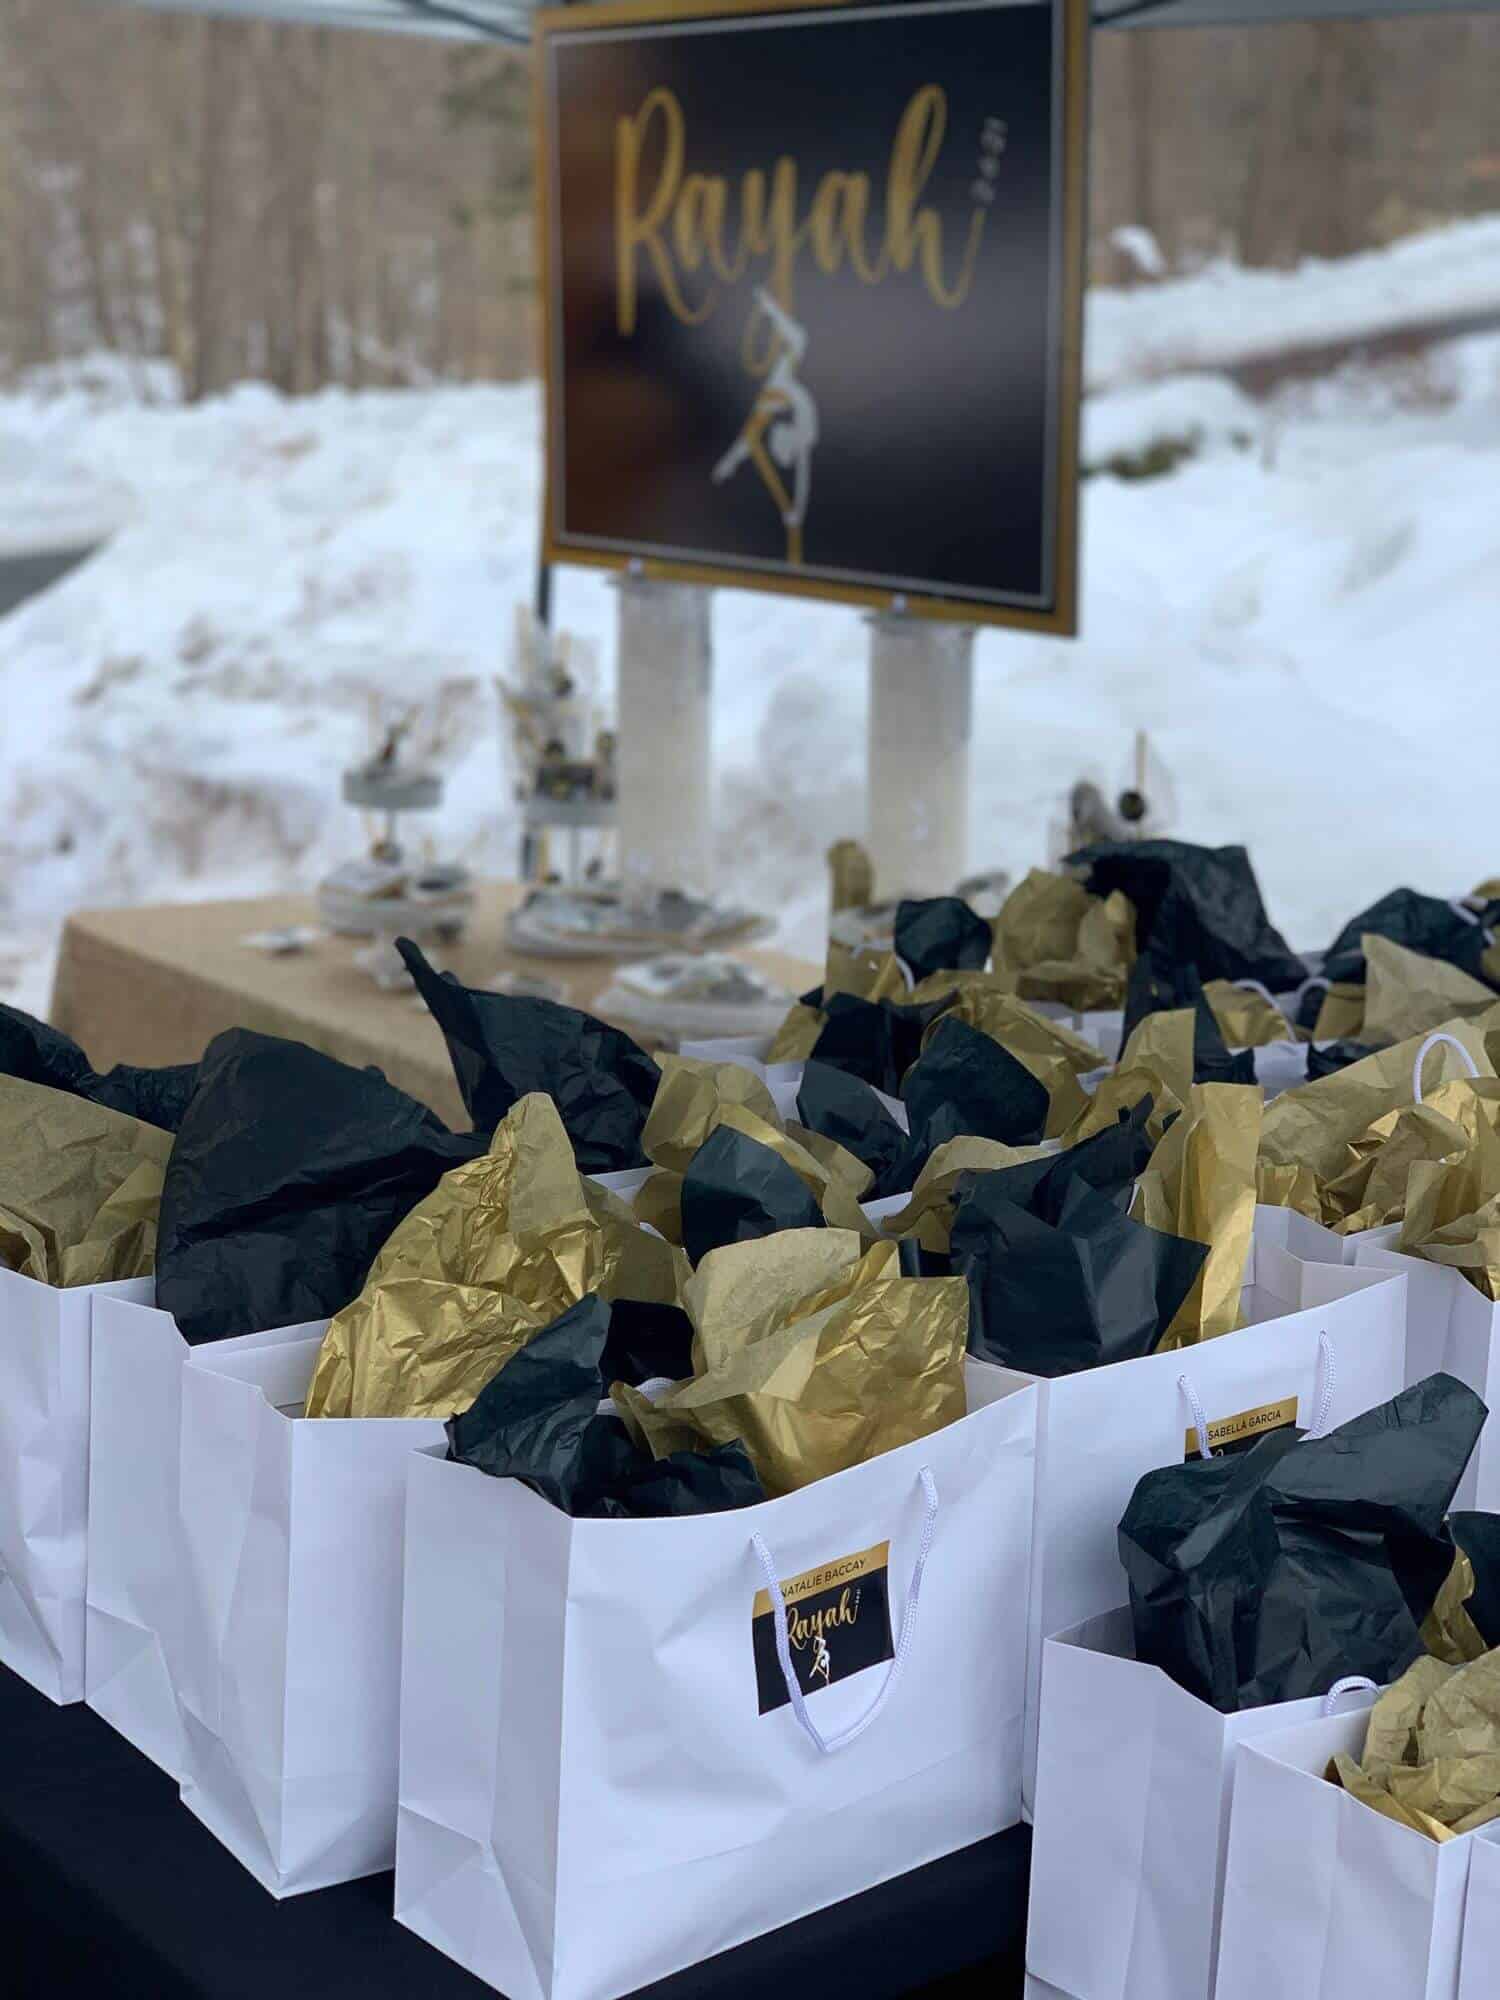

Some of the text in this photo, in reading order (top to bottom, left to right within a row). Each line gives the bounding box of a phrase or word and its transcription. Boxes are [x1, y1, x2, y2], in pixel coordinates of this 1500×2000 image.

[615, 85, 987, 375] Rayah
[1208, 1410, 1281, 1440] SABELLA GARCIA
[826, 1559, 865, 1581] BACCAY
